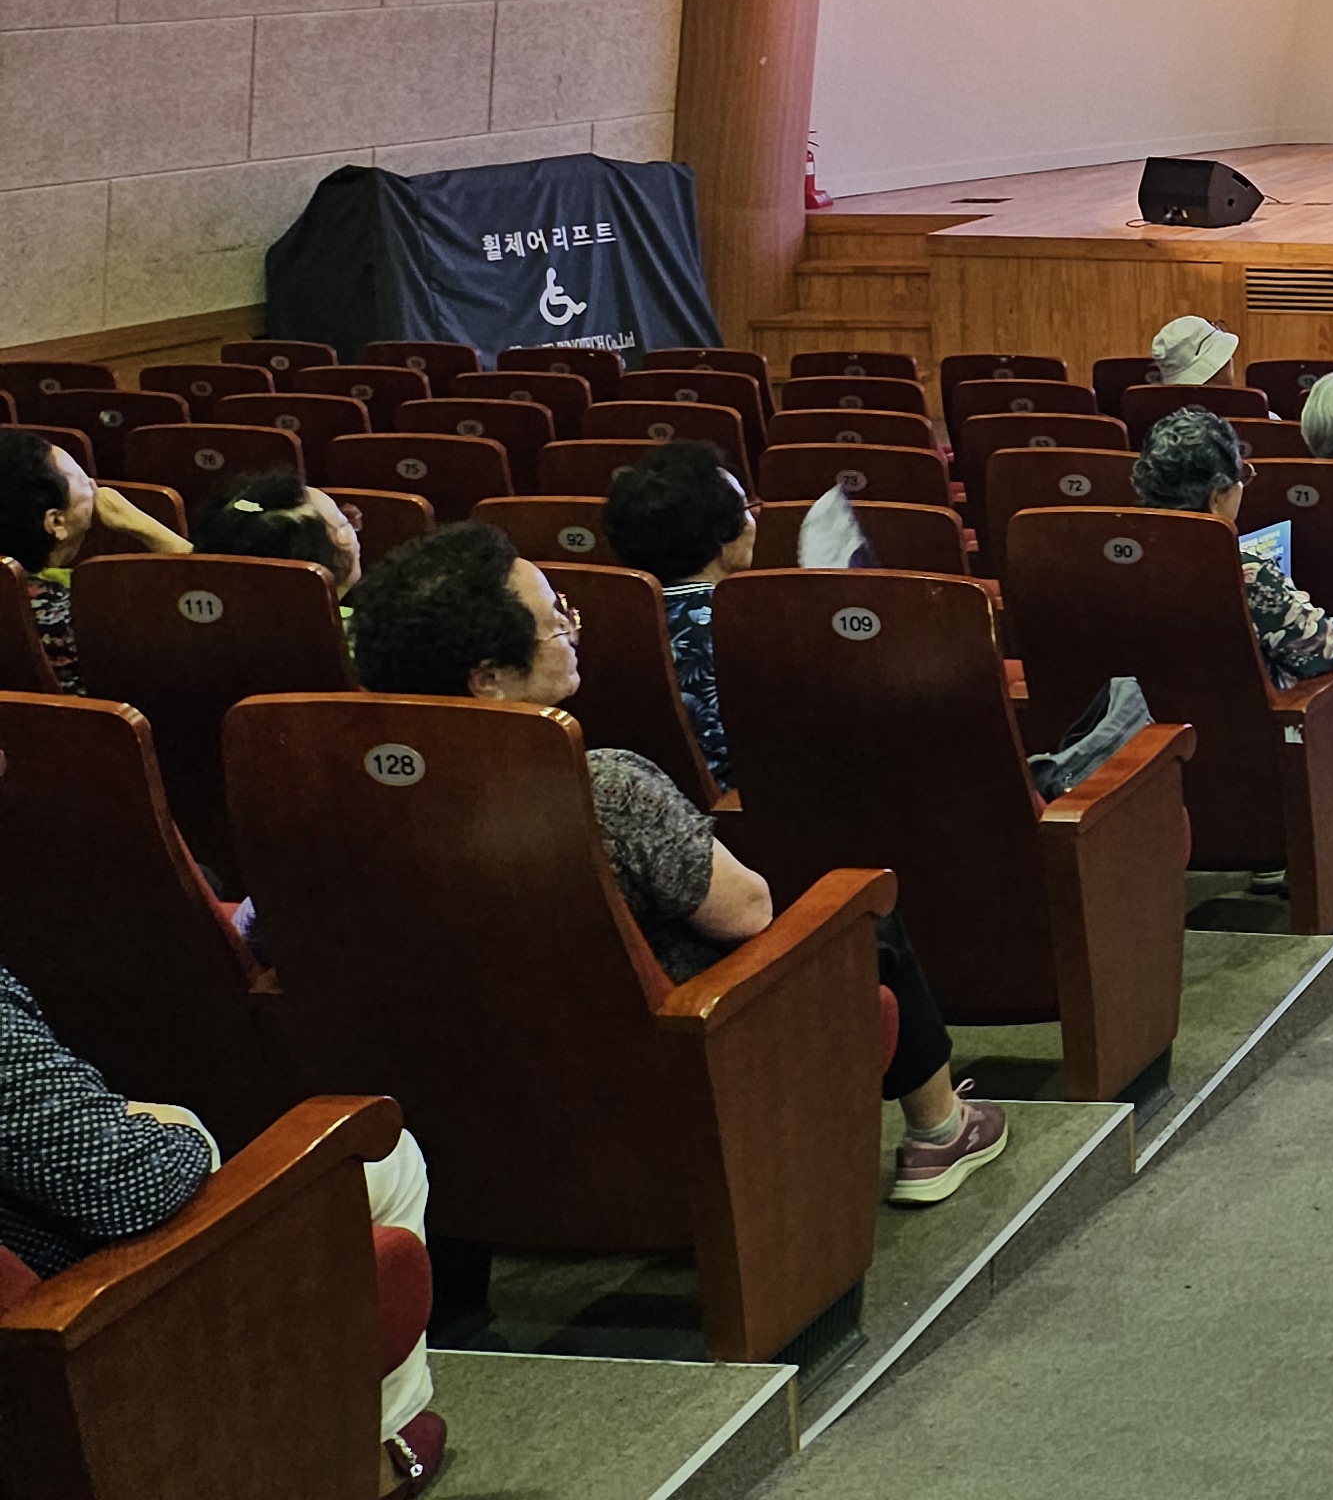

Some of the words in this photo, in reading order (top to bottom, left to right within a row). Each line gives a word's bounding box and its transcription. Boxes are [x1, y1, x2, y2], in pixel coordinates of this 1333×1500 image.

[404, 463, 420, 476] 75
[1068, 479, 1083, 492] 72
[1294, 490, 1309, 502] 71
[567, 533, 586, 547] 92
[1113, 544, 1133, 559] 90
[186, 599, 214, 615] 111
[838, 616, 874, 632] 109
[372, 753, 417, 778] 128
